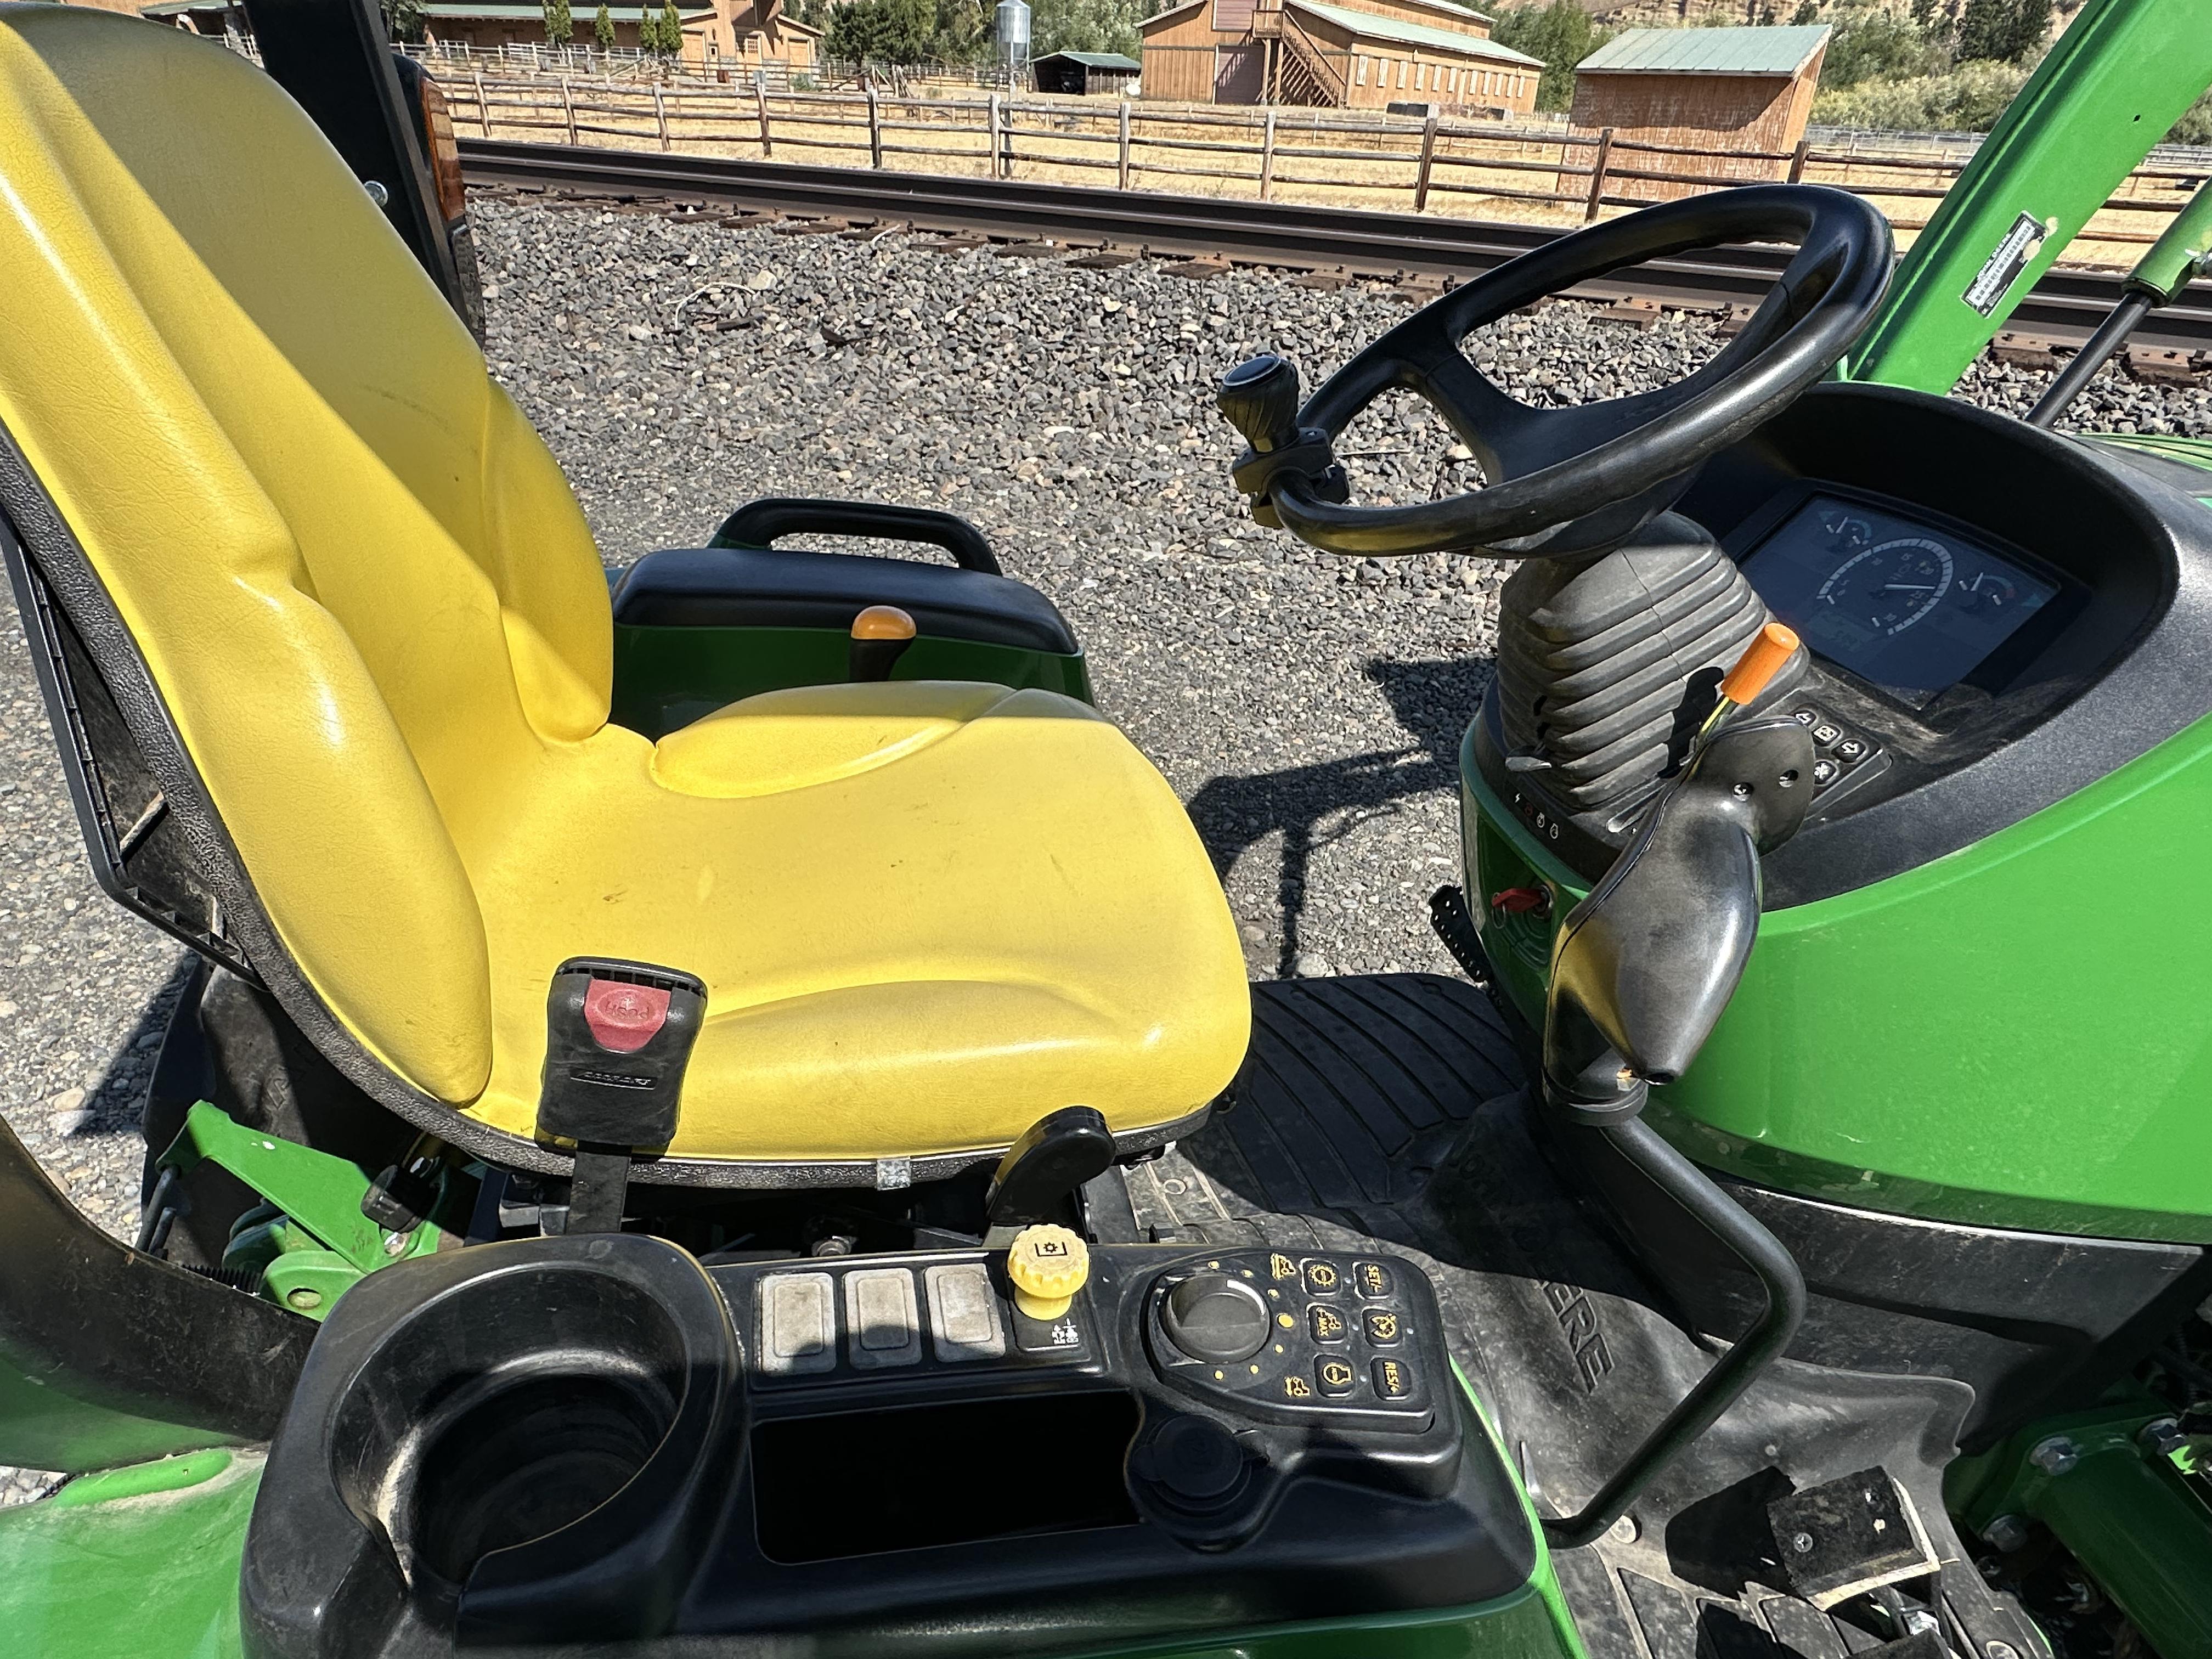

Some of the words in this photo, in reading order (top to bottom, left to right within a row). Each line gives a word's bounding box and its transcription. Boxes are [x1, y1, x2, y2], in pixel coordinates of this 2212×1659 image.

[605, 1001, 651, 1020] PUSH
[1317, 1318, 1330, 1337] MAX
[1383, 1361, 1400, 1393] RES/+
